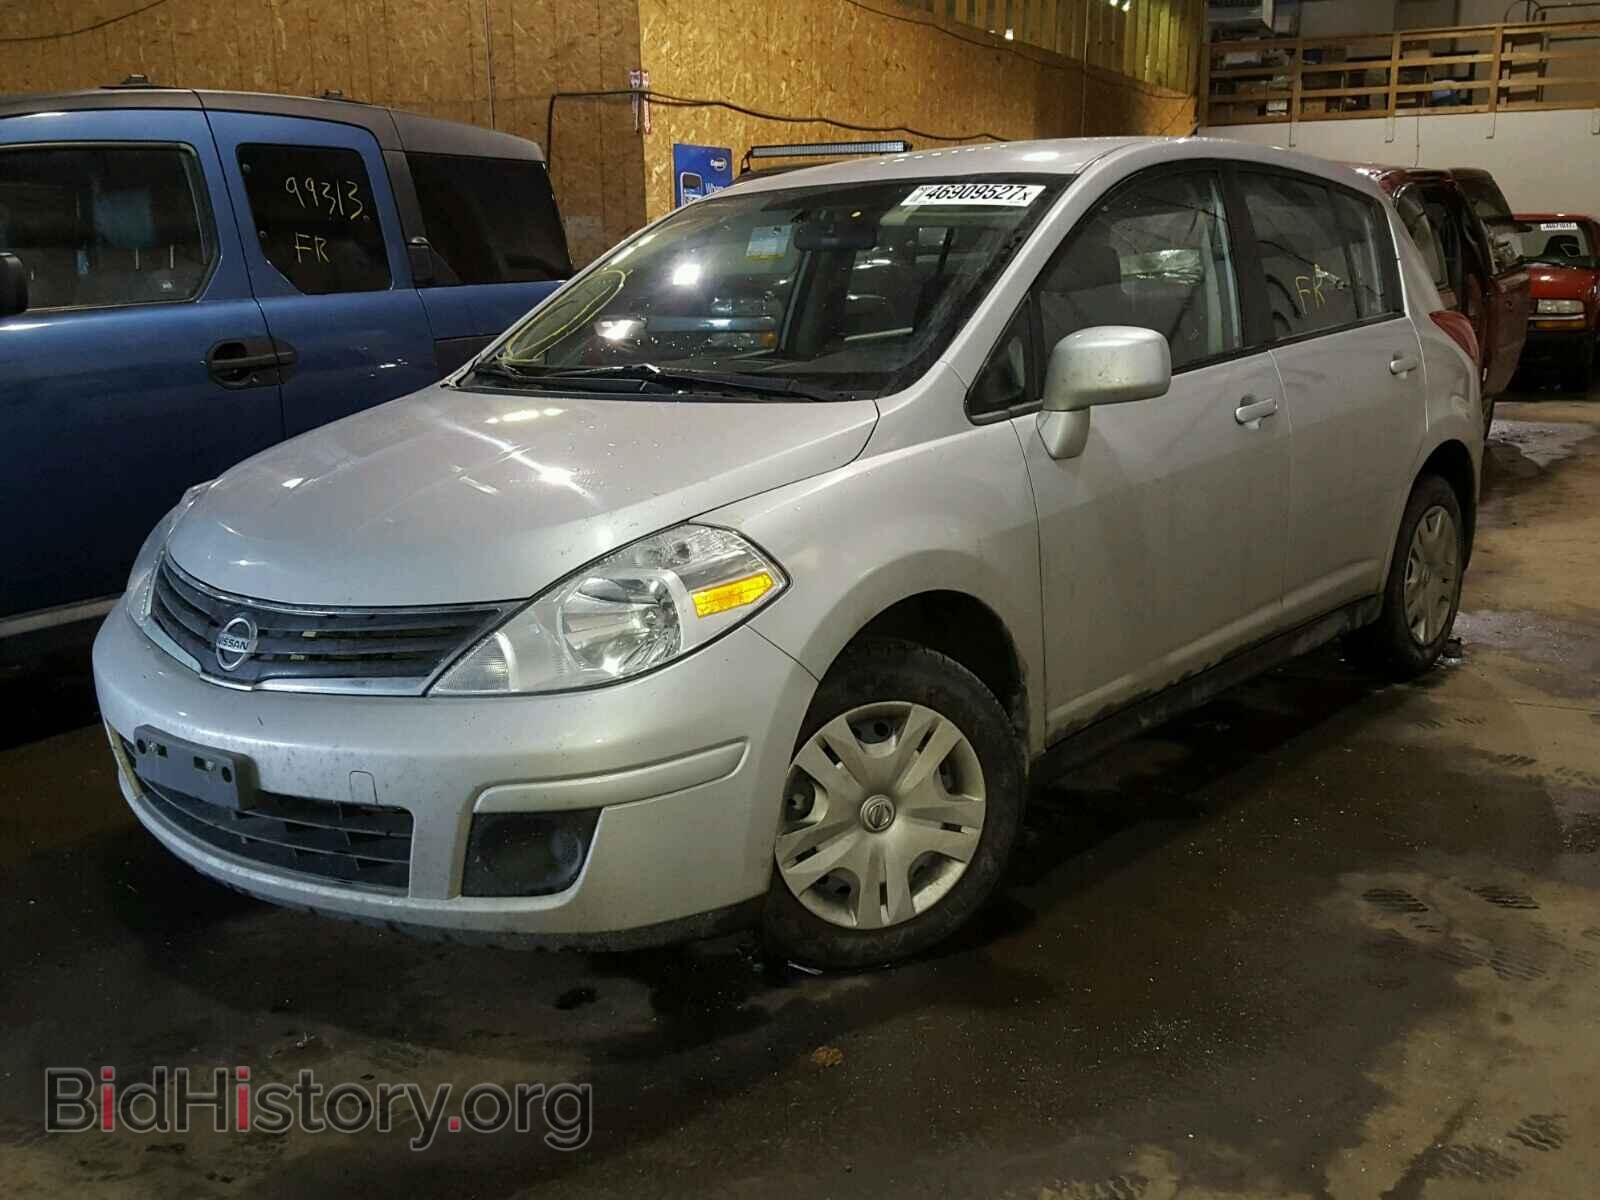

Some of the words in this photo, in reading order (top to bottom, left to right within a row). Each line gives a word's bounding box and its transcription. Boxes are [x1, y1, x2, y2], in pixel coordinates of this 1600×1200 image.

[285, 176, 363, 220] 99313
[294, 232, 330, 264] FR
[217, 637, 249, 650] NISSAN
